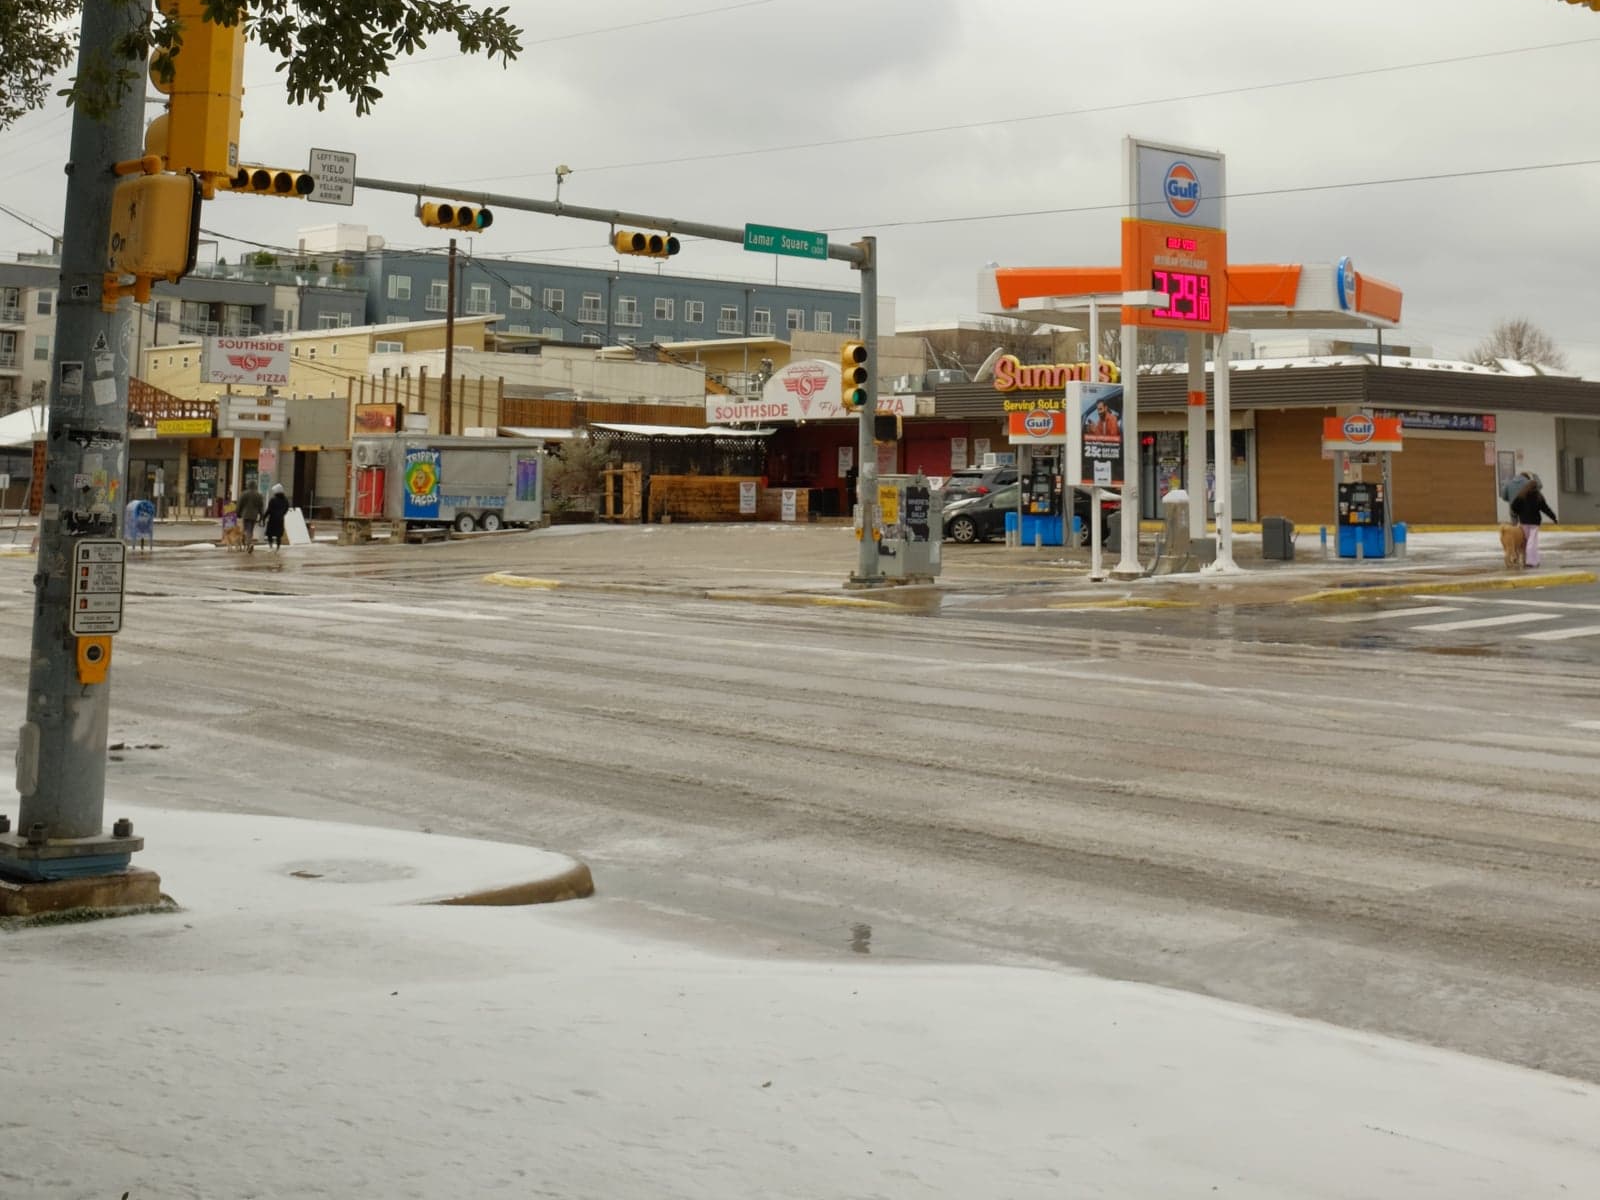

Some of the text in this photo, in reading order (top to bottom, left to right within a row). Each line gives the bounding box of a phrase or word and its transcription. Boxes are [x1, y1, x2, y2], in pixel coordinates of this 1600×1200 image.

[333, 155, 350, 163] TURN
[321, 164, 344, 174] YIELD
[319, 183, 343, 192] YELLOW
[1167, 179, 1198, 199] Gulf
[319, 192, 341, 200] ARROW
[748, 231, 809, 250] Lamar Square
[218, 340, 284, 351] SOUTHSIDE
[256, 373, 287, 383] PIZZA
[993, 354, 1118, 392] Sunns
[1003, 400, 1035, 411] Serving
[1038, 399, 1059, 409] SoLa
[715, 403, 789, 420] SOUTHSIDE
[1026, 418, 1052, 428] Gulf
[1344, 423, 1372, 433] Gulf
[407, 451, 440, 463] TRIPPY
[411, 494, 438, 507] TACOS
